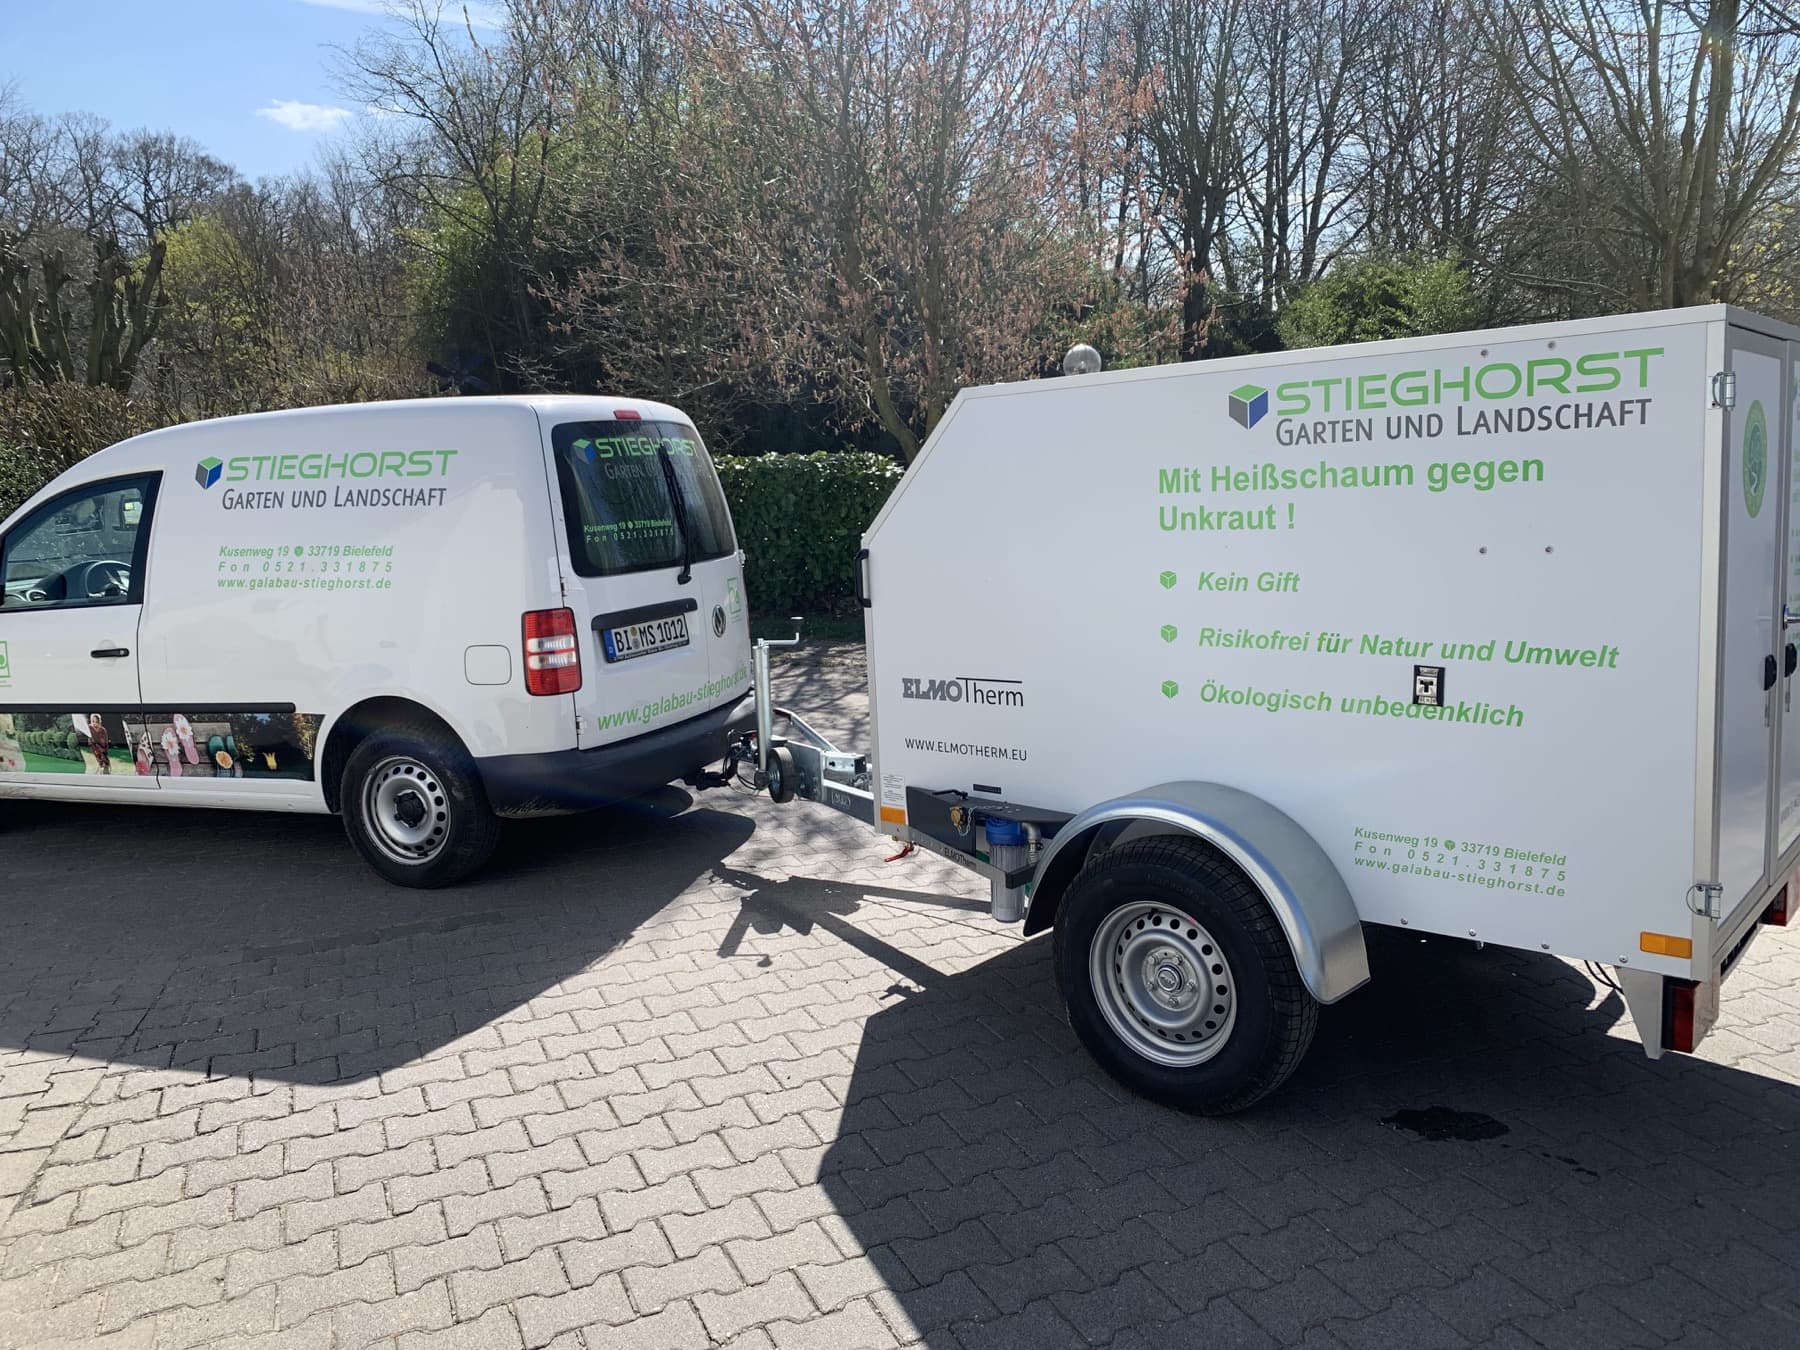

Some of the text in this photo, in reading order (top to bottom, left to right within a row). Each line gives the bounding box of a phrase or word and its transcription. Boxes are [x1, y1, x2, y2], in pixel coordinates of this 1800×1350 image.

[1276, 347, 1665, 416] STIEGHORST
[1275, 398, 1653, 447] GARTEN UND LANDSCHAFT
[226, 449, 458, 481] STIEGHORST
[1158, 457, 1544, 495] Mit Heißschaum gegen
[222, 486, 447, 510] GARTEN UND LANDSCHAFT
[1159, 503, 1277, 532] Unkraut
[218, 561, 250, 573] Fon
[219, 545, 394, 559] Kusenweg 19 33719 Bielefeld
[217, 577, 392, 591] www.galabau-stieghorst.de
[1198, 571, 1301, 593] Kein Gift
[614, 629, 633, 653] BI
[638, 624, 656, 648] MS
[657, 618, 686, 643] 1012
[1198, 627, 1620, 669] Risikofrei für Natur und Umwelt
[1199, 679, 1333, 713] Ökologisch
[904, 737, 1028, 762] WWW.ELMOTHERM.EU
[1354, 826, 1567, 867] Kusenweg 19 33719 Bielefeld
[1354, 841, 1392, 857] Fon
[1354, 857, 1566, 897] www.galabau-stieghorst.de
